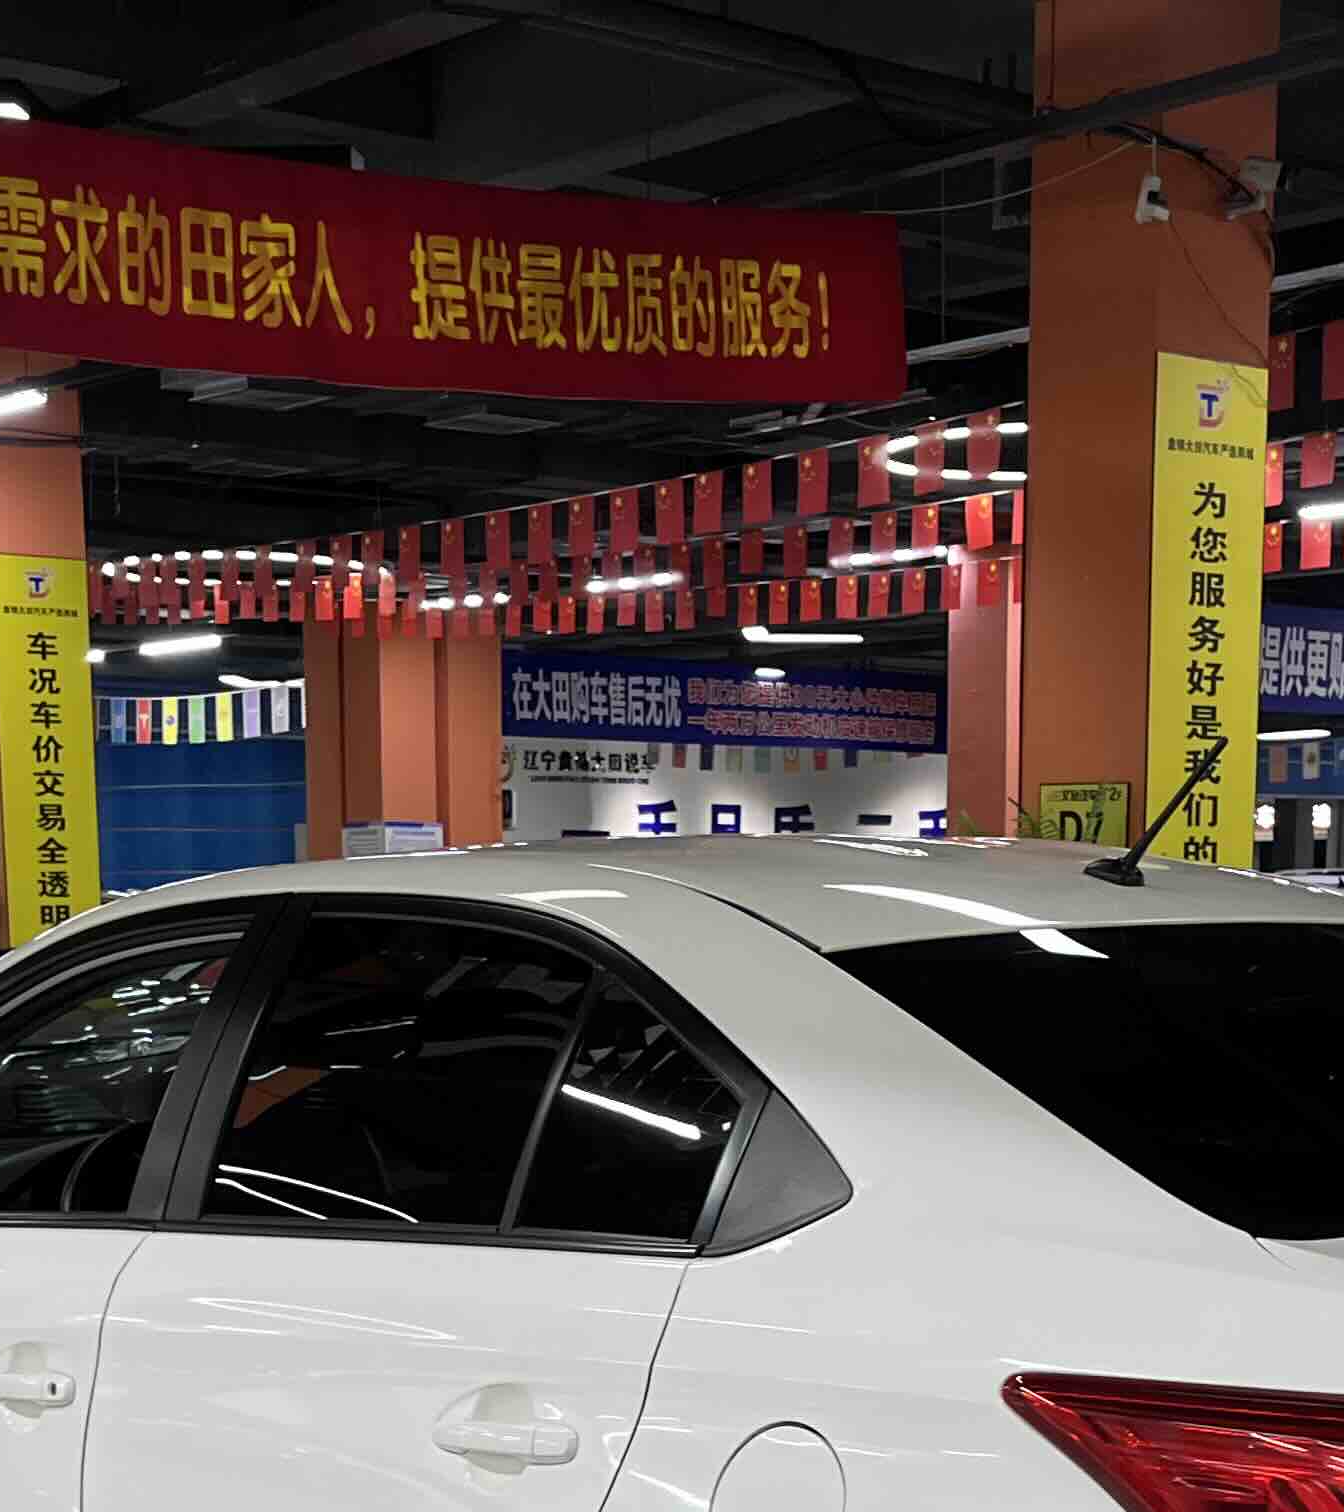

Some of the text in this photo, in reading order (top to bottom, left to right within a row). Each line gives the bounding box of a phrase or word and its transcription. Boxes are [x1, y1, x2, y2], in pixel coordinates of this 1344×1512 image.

[26, 631, 71, 926] 车况车价交易全透明
[511, 667, 682, 728] 在大田购车售后无忧
[1183, 482, 1228, 863] 为您服务好是我们的
